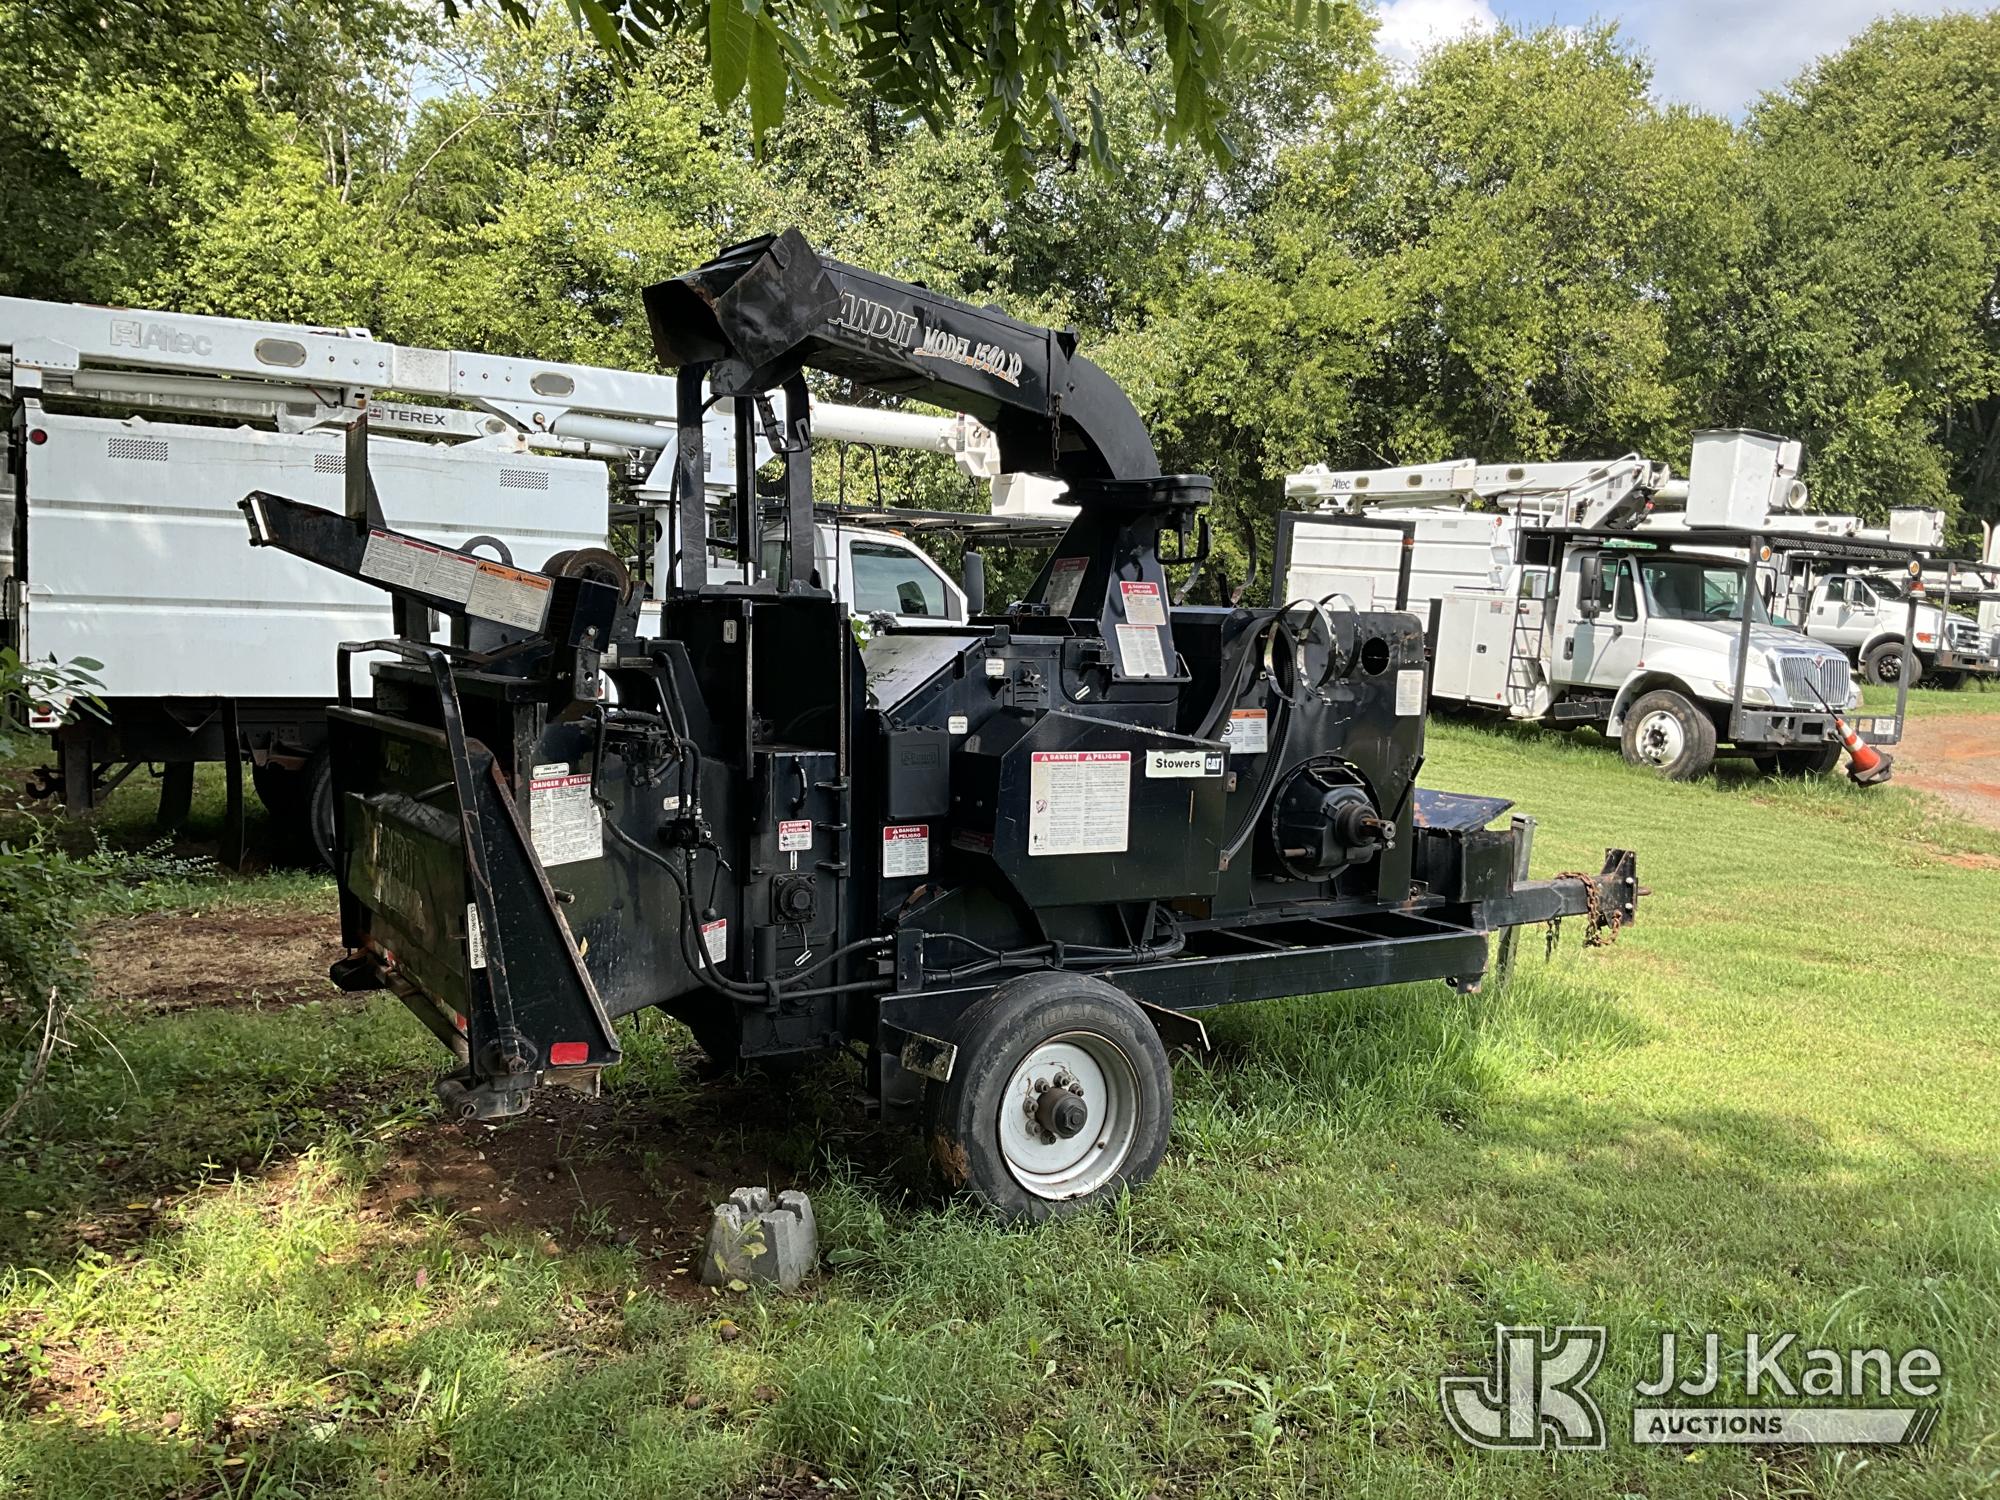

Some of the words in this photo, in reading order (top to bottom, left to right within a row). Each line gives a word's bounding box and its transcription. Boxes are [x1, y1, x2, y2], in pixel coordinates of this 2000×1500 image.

[828, 288, 919, 348] ANDIT
[923, 326, 971, 365] MODEL
[142, 323, 213, 357] Altec
[387, 409, 446, 426] TEREX
[1331, 478, 1351, 490] Altec
[1155, 758, 1201, 769] Stowers
[1205, 757, 1222, 770] CAT
[532, 780, 559, 789] DANGER
